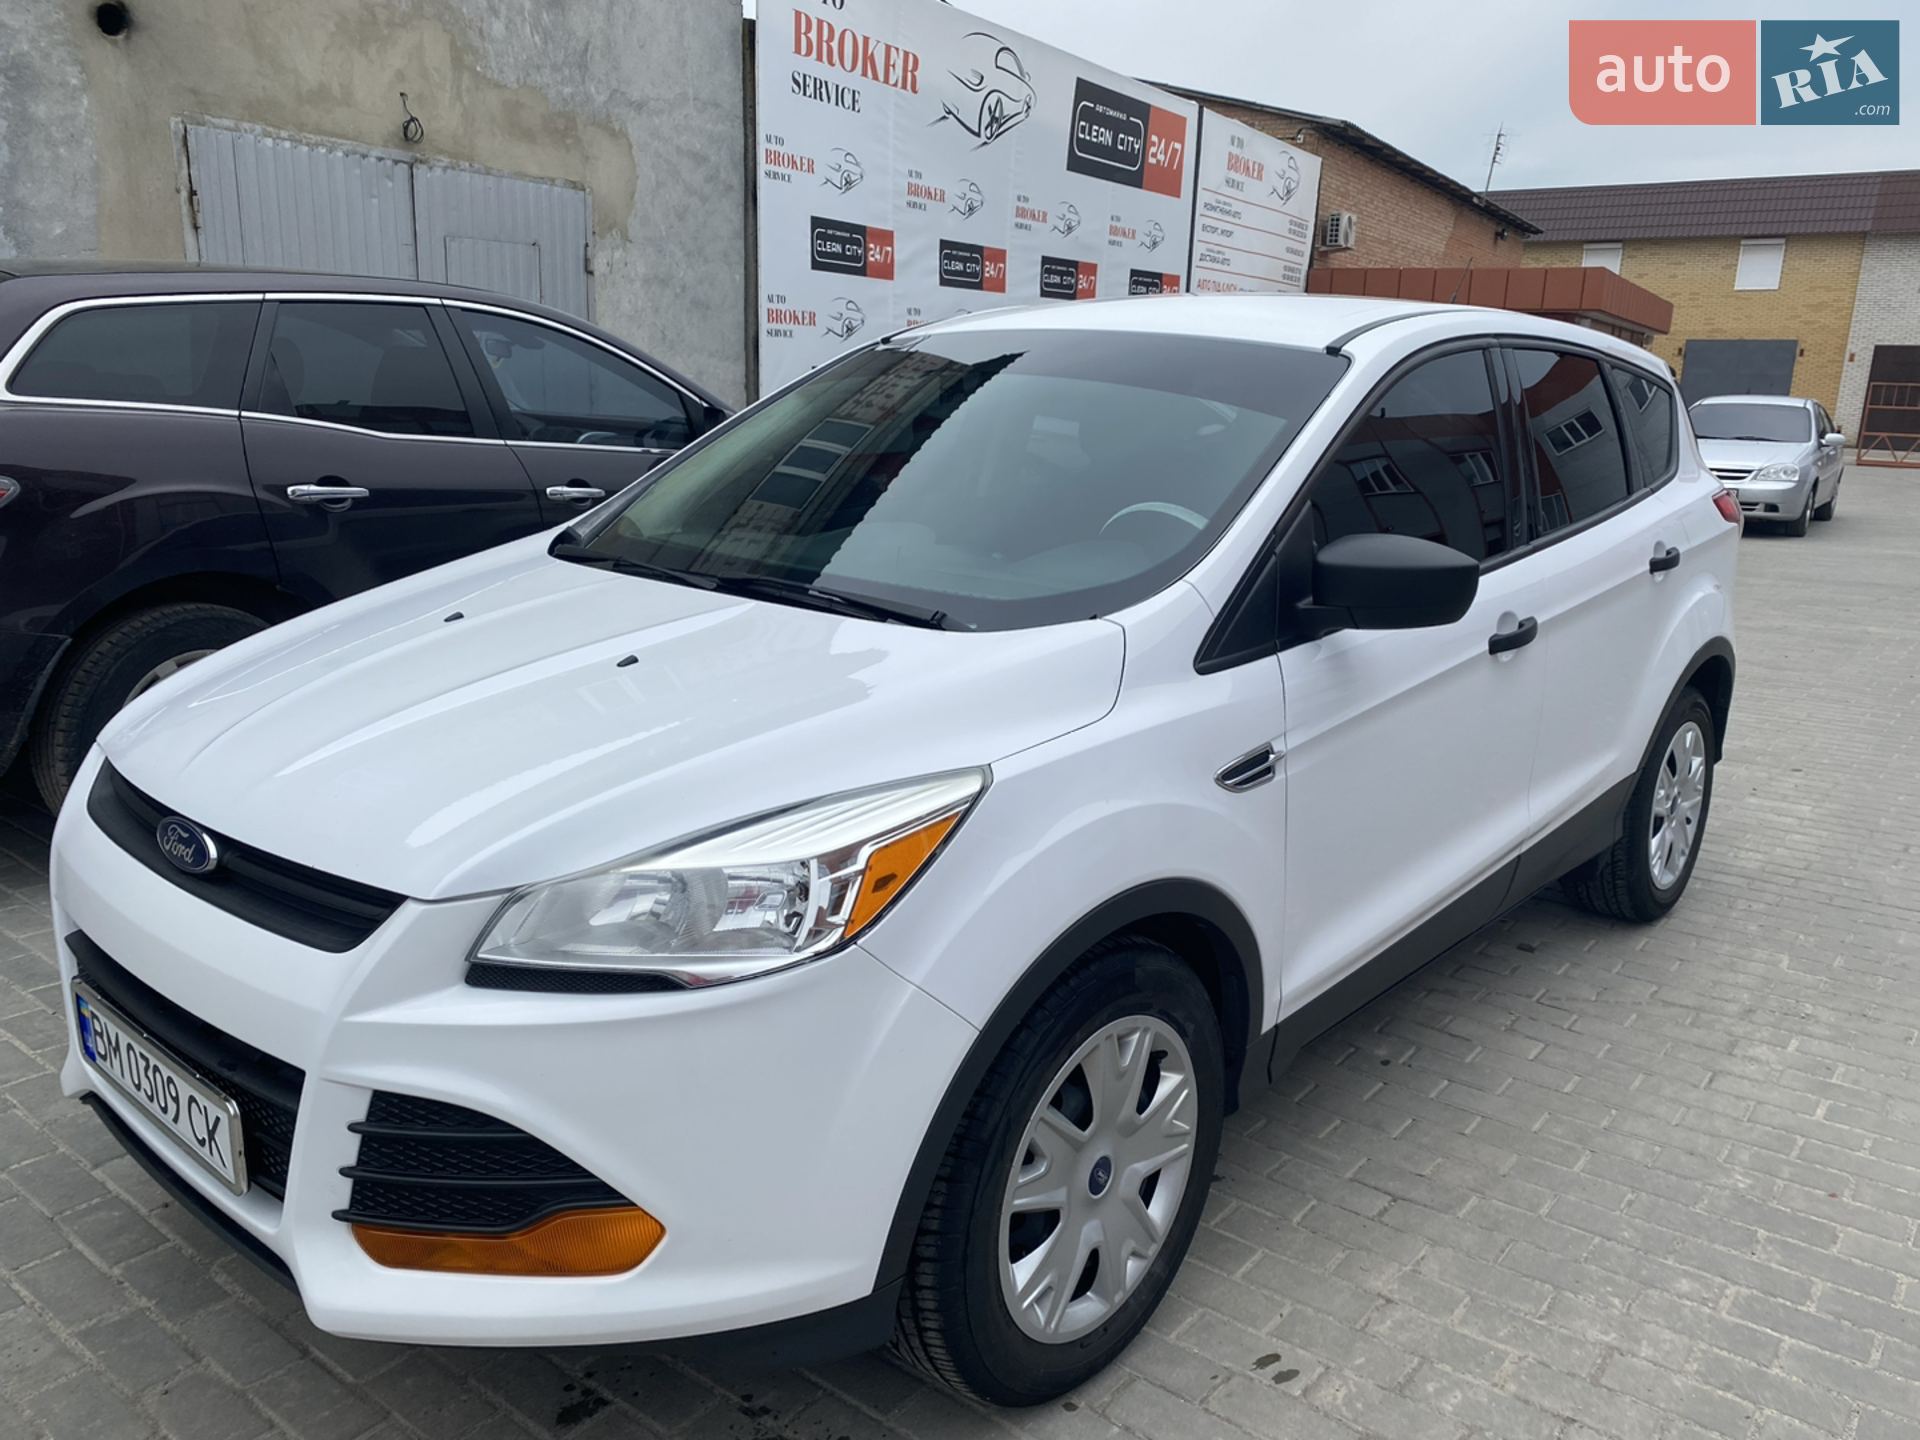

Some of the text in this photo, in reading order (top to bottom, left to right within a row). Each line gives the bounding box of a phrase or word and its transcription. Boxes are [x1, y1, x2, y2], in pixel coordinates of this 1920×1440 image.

[792, 8, 920, 95] BROKER
[791, 70, 861, 114] SERVICE
[764, 133, 785, 147] AUTO
[1078, 120, 1141, 155] CLEAN CITY
[764, 148, 816, 175] BROKER
[1148, 134, 1182, 170] 24/7
[764, 169, 792, 183] SERVICE
[1226, 151, 1265, 182] BROKER
[907, 181, 946, 203] BROKER
[1015, 205, 1048, 223] BROKER
[1109, 224, 1137, 240] BROKER
[816, 239, 863, 256] CLEAN CITY
[868, 243, 893, 264] 24/7
[943, 260, 980, 273] CLEAN CITY
[984, 261, 1005, 279] 24/7
[1043, 273, 1075, 285] CLEAN CITY
[1078, 274, 1096, 290] 24/7
[766, 294, 786, 305] AUTO
[766, 307, 817, 327] BROKER
[766, 328, 793, 339] SERVICE
[163, 824, 196, 863] Ford
[91, 1010, 228, 1169] BM 0309 CK
